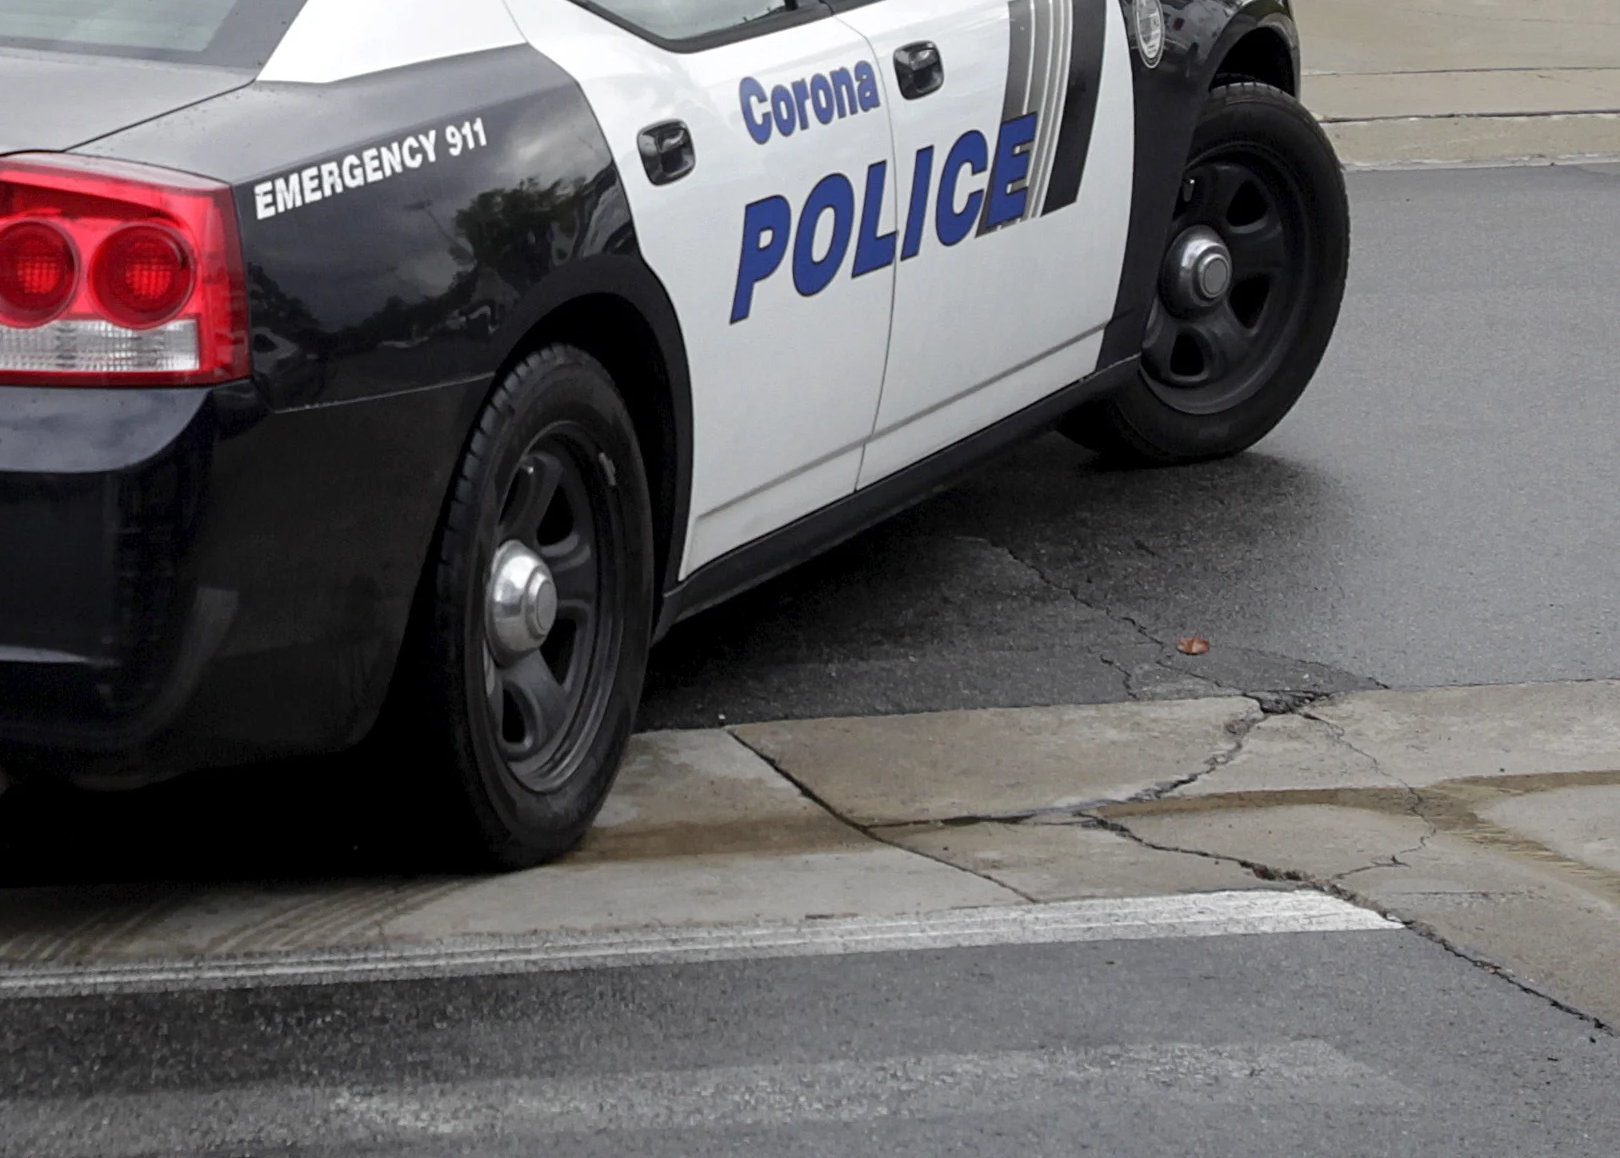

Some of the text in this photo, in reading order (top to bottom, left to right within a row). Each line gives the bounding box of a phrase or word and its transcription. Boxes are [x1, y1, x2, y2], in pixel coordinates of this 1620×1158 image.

[739, 60, 881, 144] Corona
[254, 117, 487, 220] EMERGENCY 911
[729, 111, 1038, 324] POLICE
